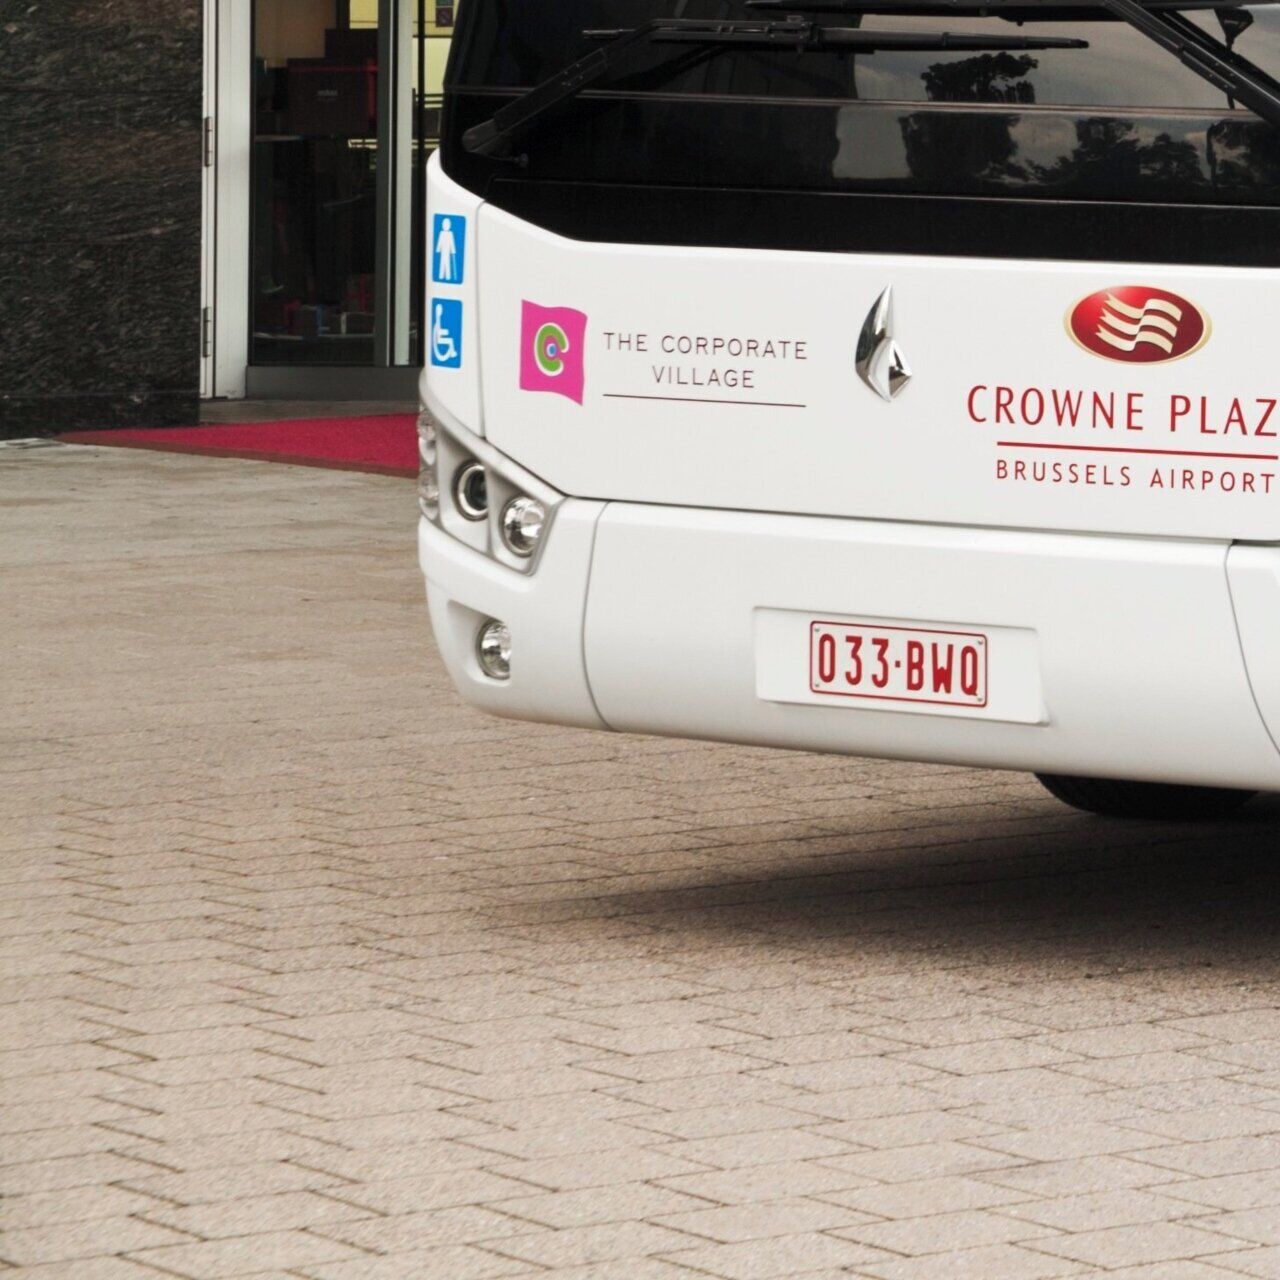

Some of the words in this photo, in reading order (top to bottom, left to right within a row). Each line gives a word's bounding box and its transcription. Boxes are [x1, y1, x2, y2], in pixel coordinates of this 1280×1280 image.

[604, 332, 647, 352] THE
[661, 335, 807, 359] CORPORATE
[653, 366, 755, 388] VILLAGE
[968, 385, 1144, 431] CROWNE
[996, 460, 1130, 486] BRUSSELS
[1150, 469, 1275, 494] AIRPORT
